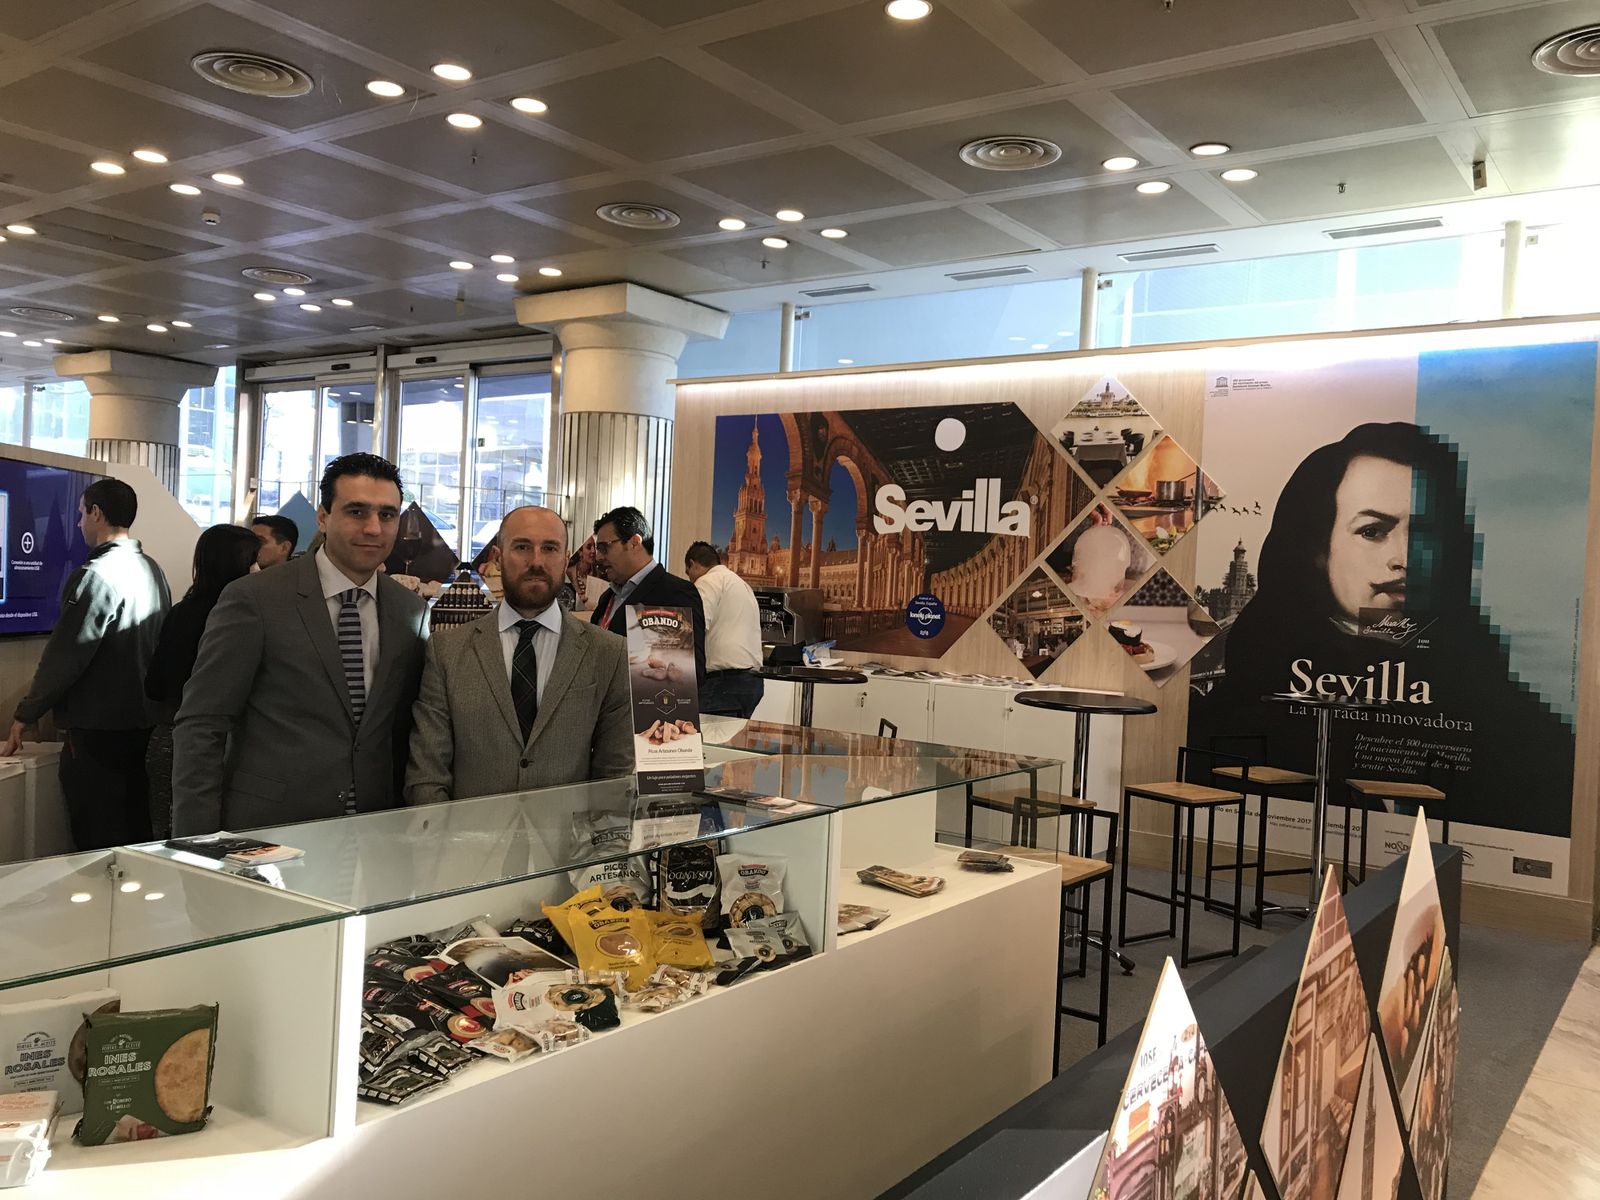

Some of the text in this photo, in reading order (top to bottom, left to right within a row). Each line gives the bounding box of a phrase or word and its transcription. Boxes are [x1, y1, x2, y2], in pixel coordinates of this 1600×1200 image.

[873, 478, 1031, 538] Sevilla
[642, 616, 678, 628] OBANDO
[1290, 658, 1433, 705] Sevilla
[1375, 711, 1473, 732] innovadora
[1354, 742, 1369, 750] del
[1370, 745, 1419, 757] nacimiento
[1355, 733, 1394, 745] Descubre
[1395, 737, 1404, 746] el
[1421, 741, 1473, 753] aniversario
[1360, 762, 1384, 771] sentir
[1296, 817, 1312, 825] 2017
[603, 862, 628, 872] PICOS
[589, 870, 641, 884] ARTESANOS
[20, 1049, 53, 1062] INES
[104, 1052, 137, 1065] INES
[5, 1057, 66, 1075] ROSALES
[88, 1061, 152, 1077] ROSALES
